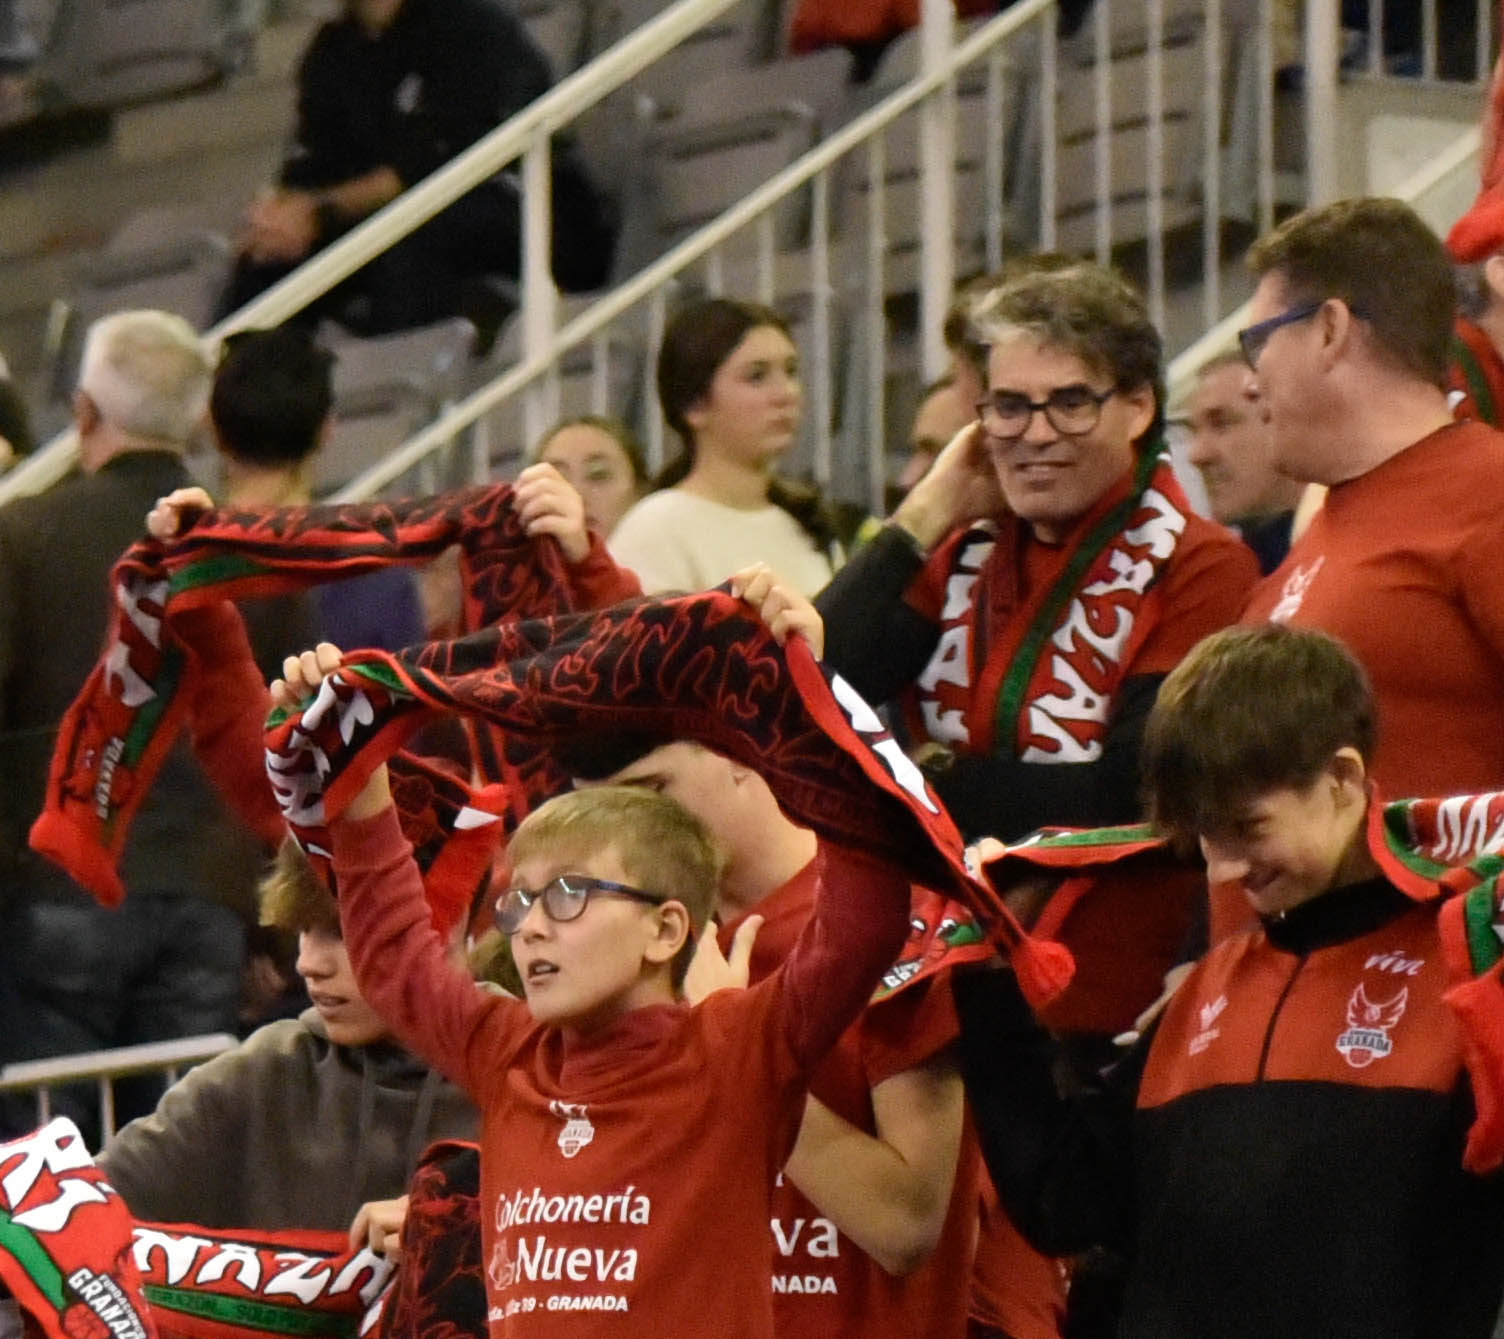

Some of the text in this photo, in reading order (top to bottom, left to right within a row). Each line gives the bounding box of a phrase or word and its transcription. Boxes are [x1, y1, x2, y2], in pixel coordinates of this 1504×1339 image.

[515, 1236, 639, 1284] Nueva
[770, 1274, 838, 1295] NADA
[546, 1294, 629, 1313] GRANADA
